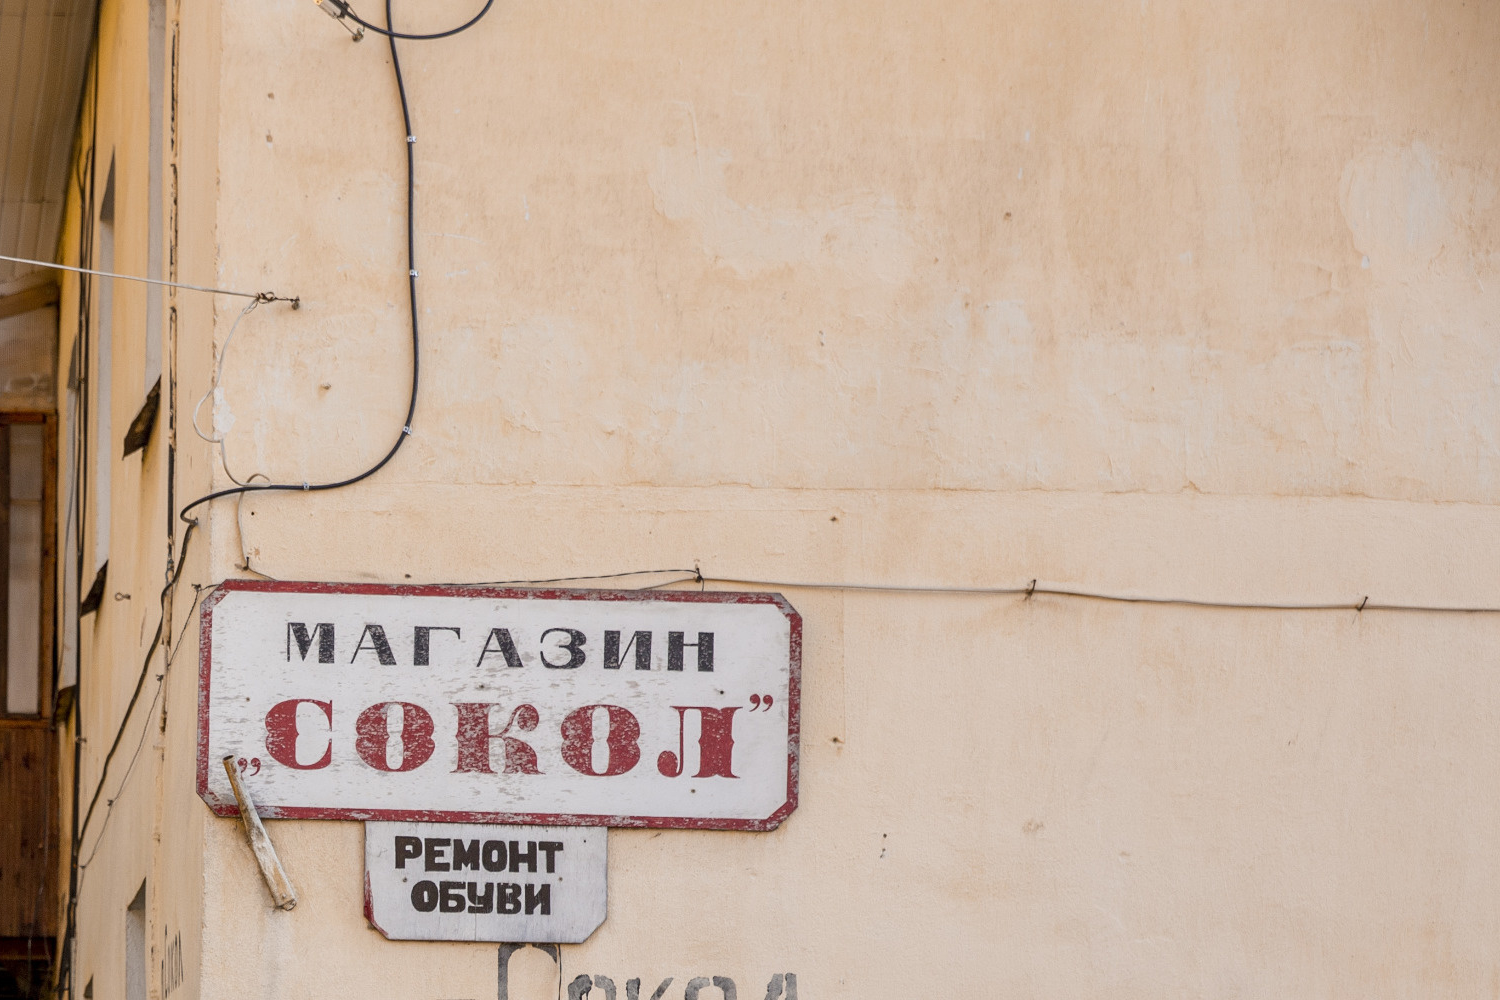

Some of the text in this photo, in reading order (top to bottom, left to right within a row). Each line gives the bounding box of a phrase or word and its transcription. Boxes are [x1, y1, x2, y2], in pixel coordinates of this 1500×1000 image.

[285, 622, 715, 672] МАГАЗИН
[393, 835, 564, 873] РЕМОНТ
[410, 880, 552, 915] ОБУВИ
